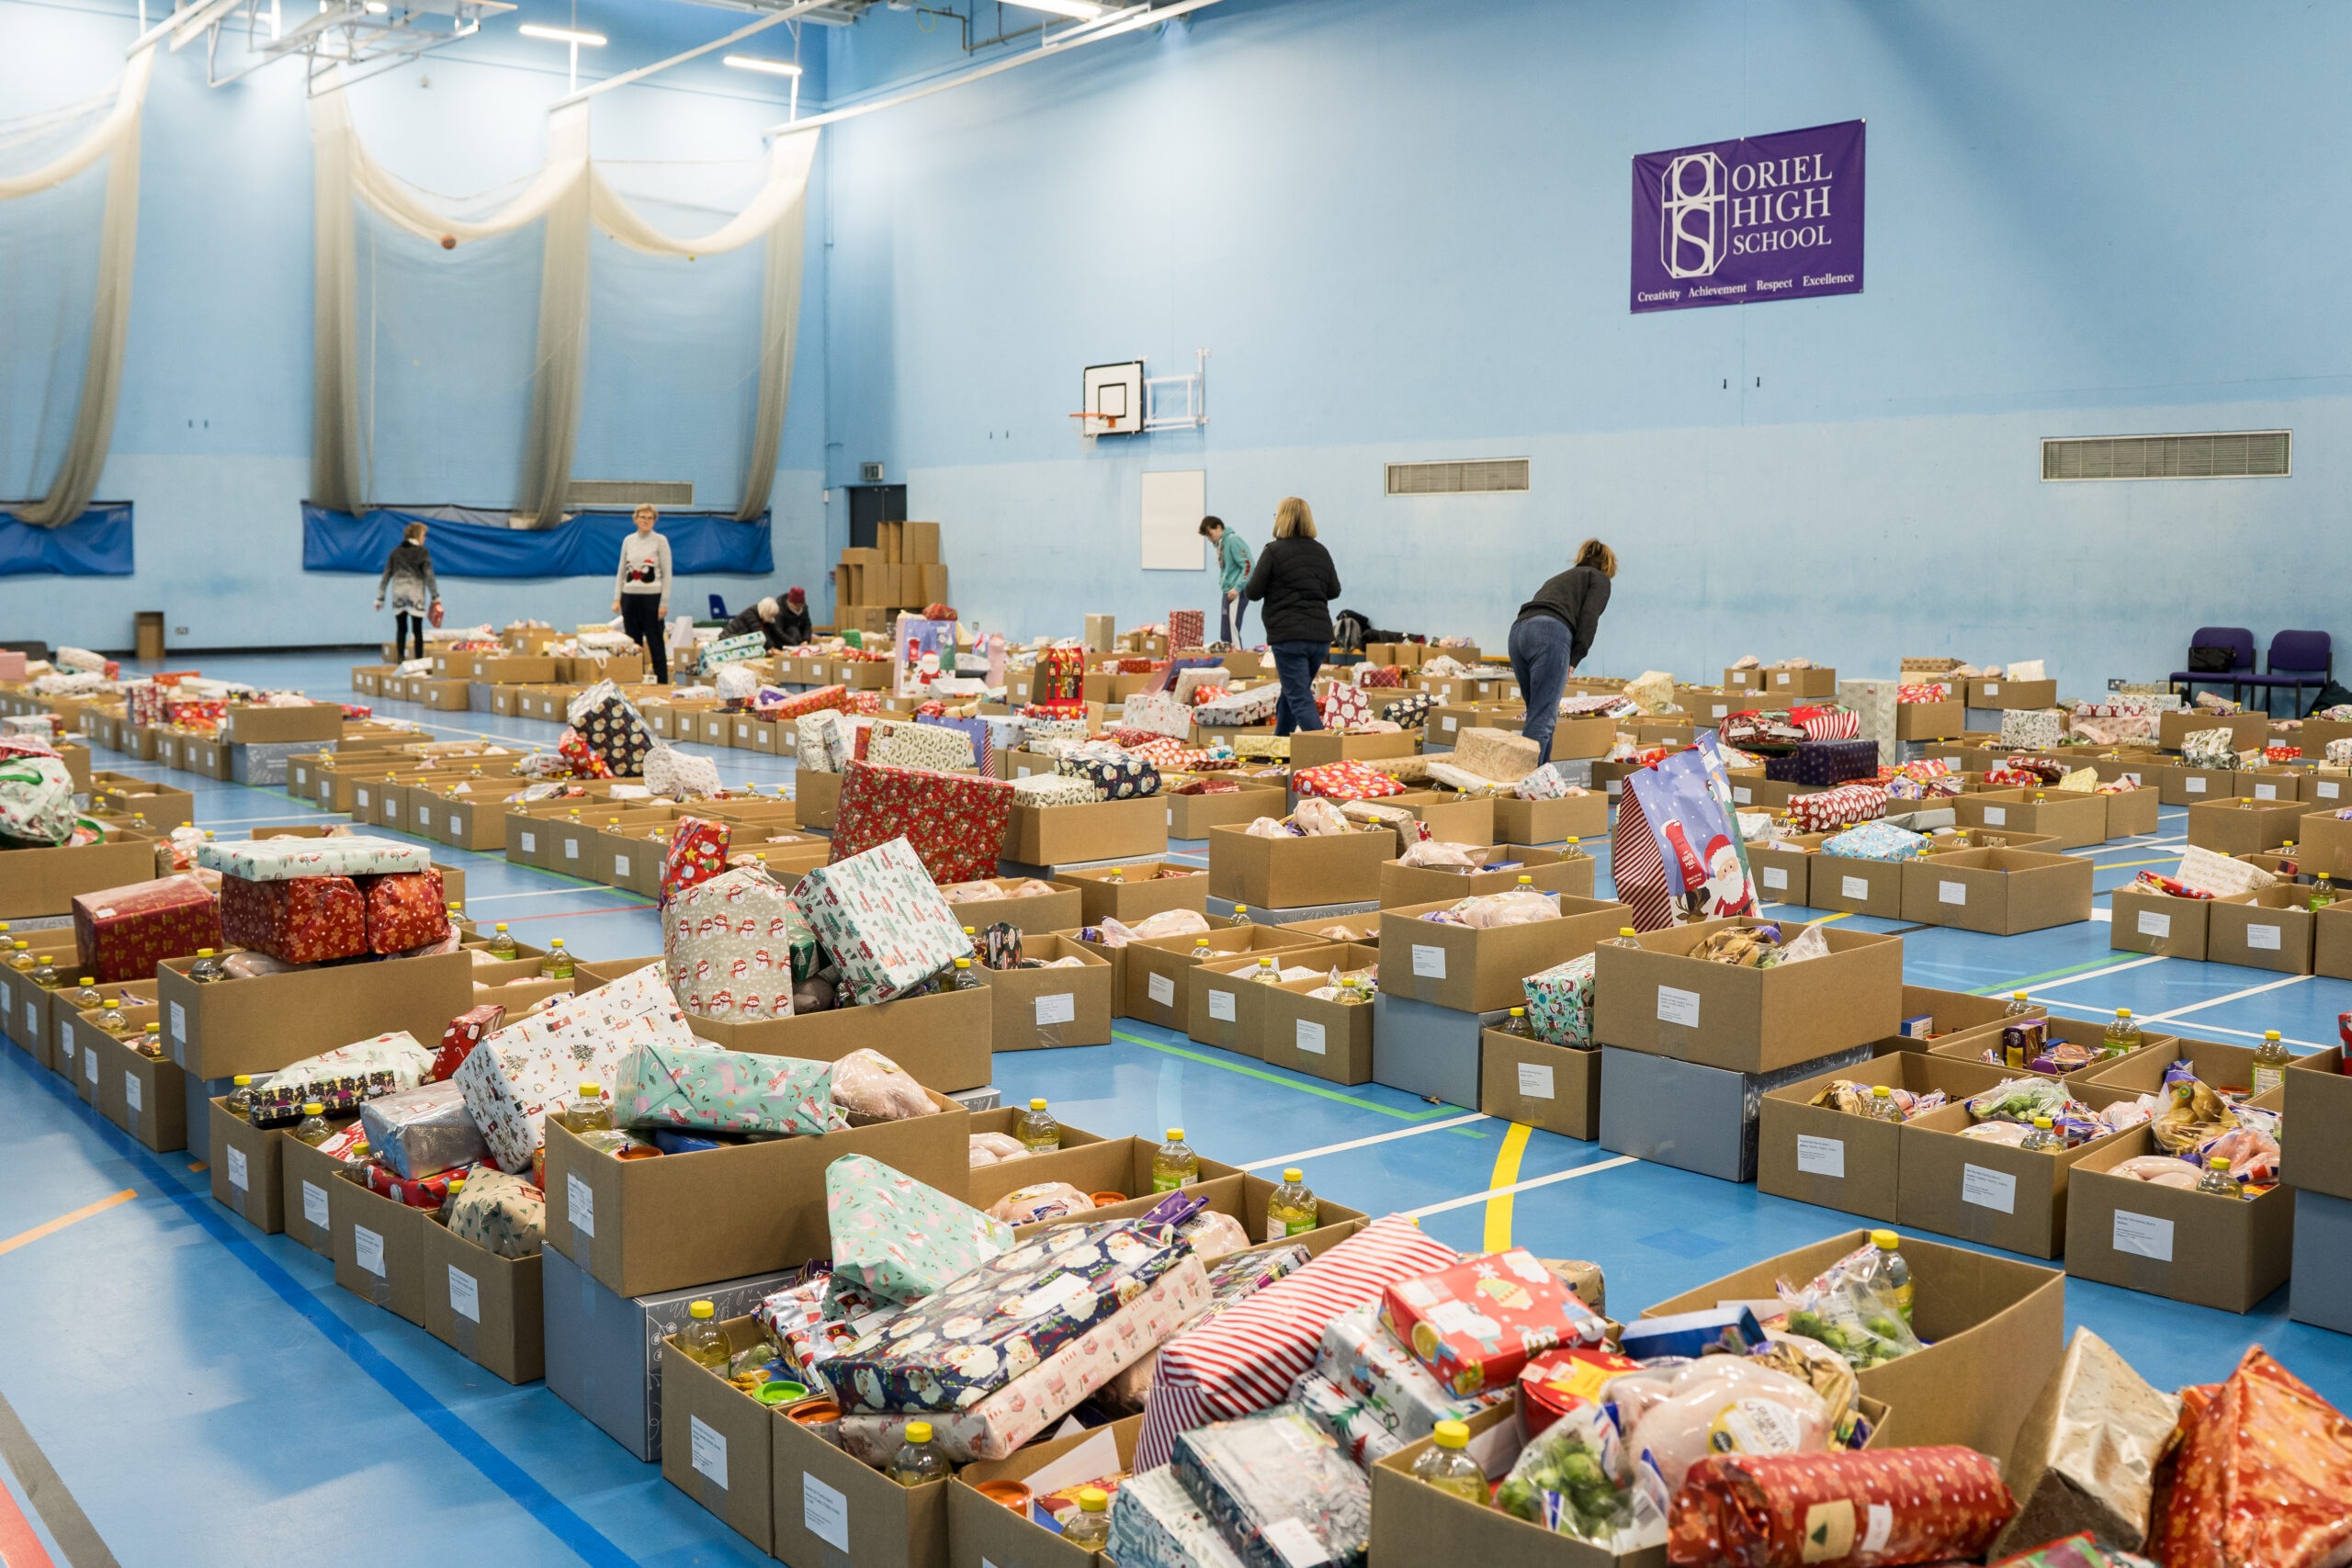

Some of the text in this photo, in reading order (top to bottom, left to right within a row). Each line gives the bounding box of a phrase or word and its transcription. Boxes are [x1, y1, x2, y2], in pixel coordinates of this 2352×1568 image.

[1732, 153, 1833, 192] ORIEL
[1731, 186, 1832, 229] HIGH
[1732, 225, 1832, 255] SCHOOL
[1638, 273, 1854, 302] Creativity Achievement Respect Excellence
